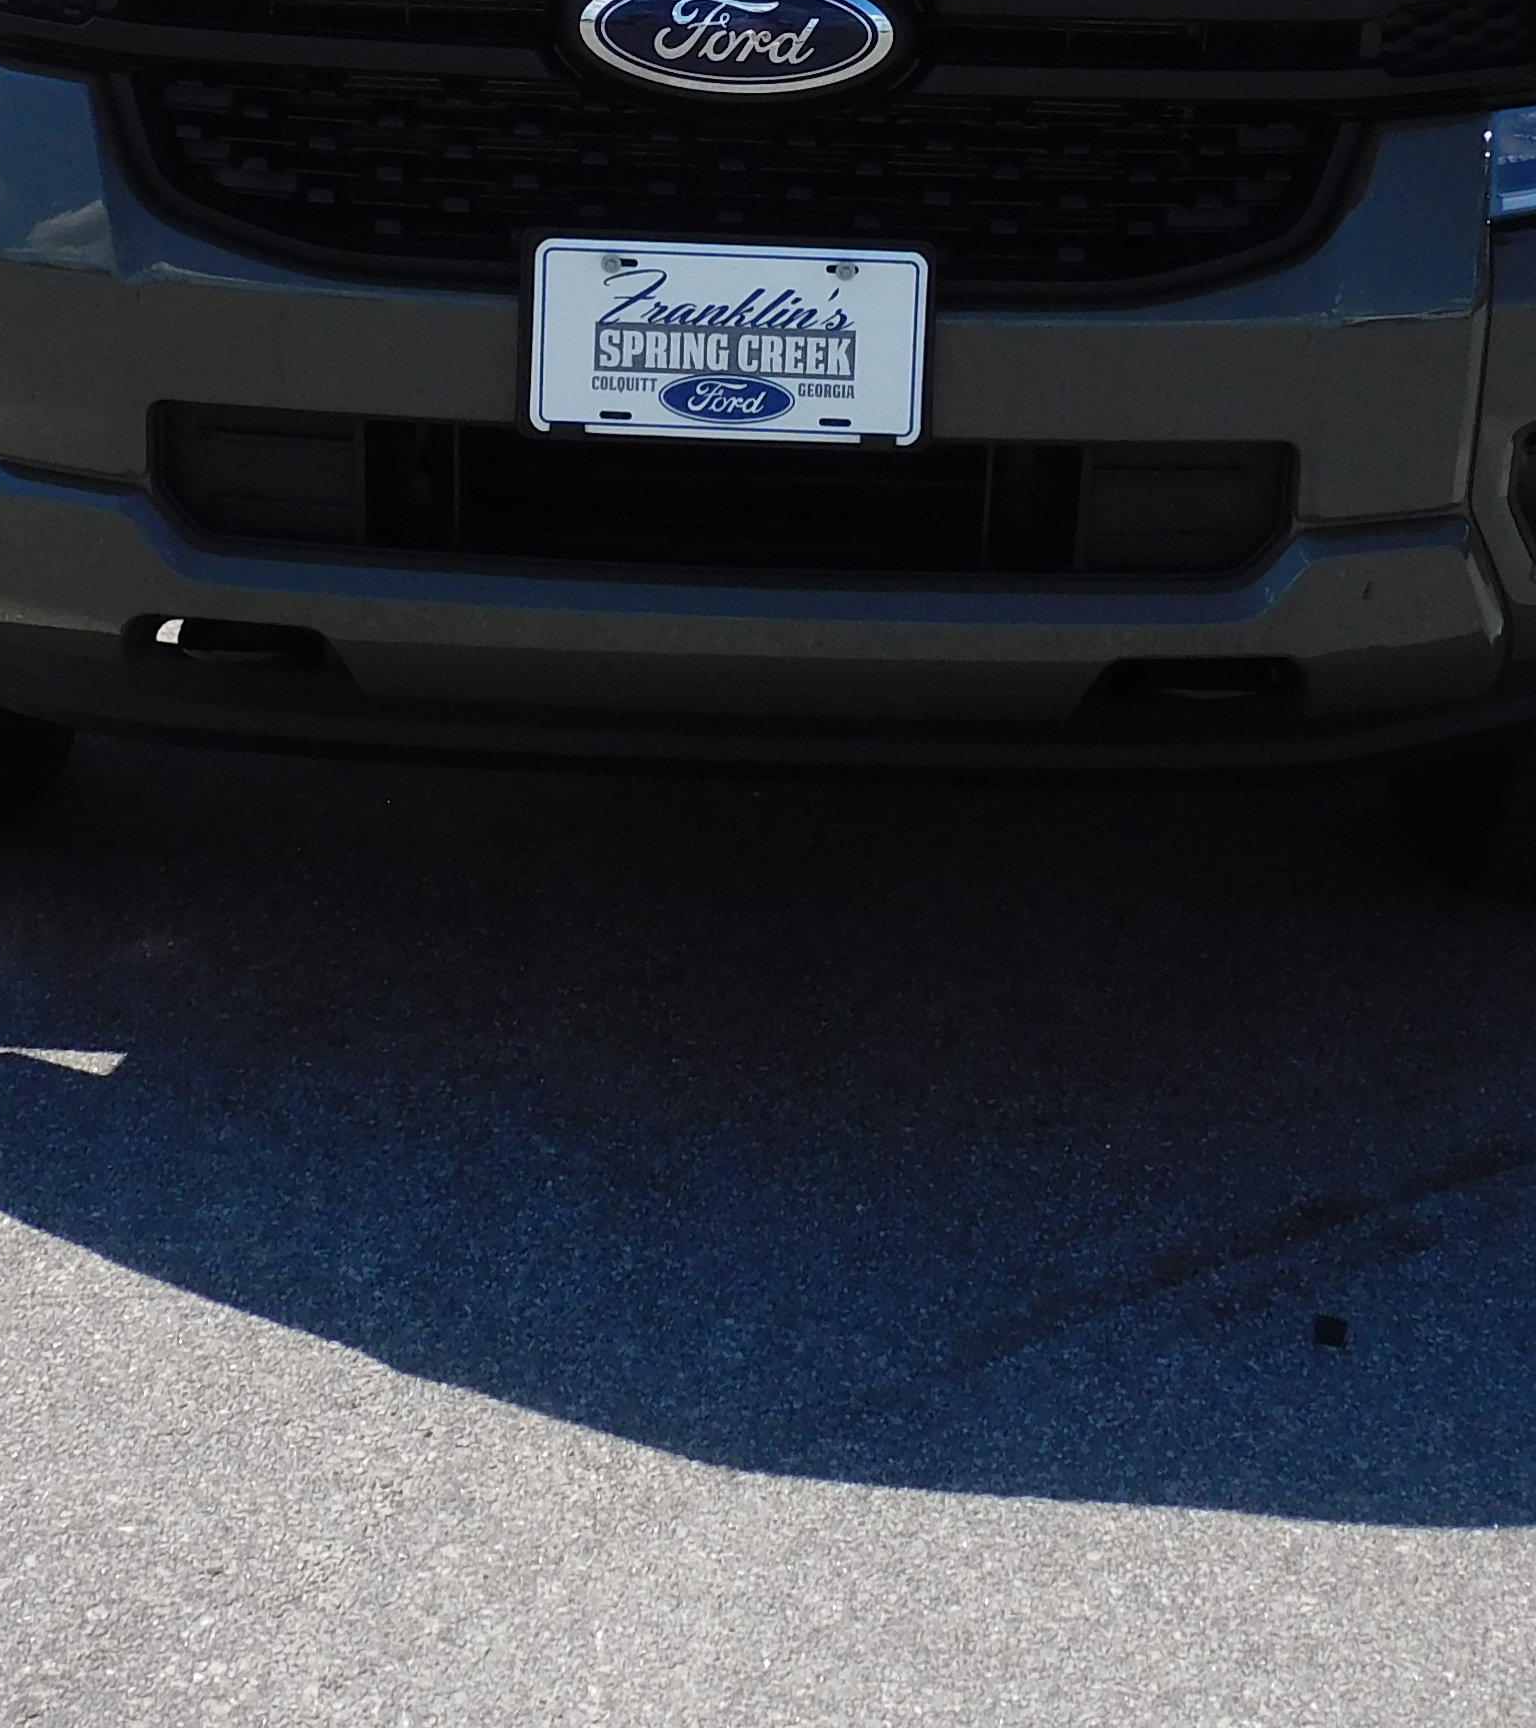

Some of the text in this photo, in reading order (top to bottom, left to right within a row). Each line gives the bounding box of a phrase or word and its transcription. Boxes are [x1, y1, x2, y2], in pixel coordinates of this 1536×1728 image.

[599, 269, 855, 330] Franklin's
[598, 329, 853, 376] SPRING CREEK
[591, 375, 658, 393] COLQUITT
[687, 380, 767, 414] Ford
[798, 383, 855, 399] GEORGIA
